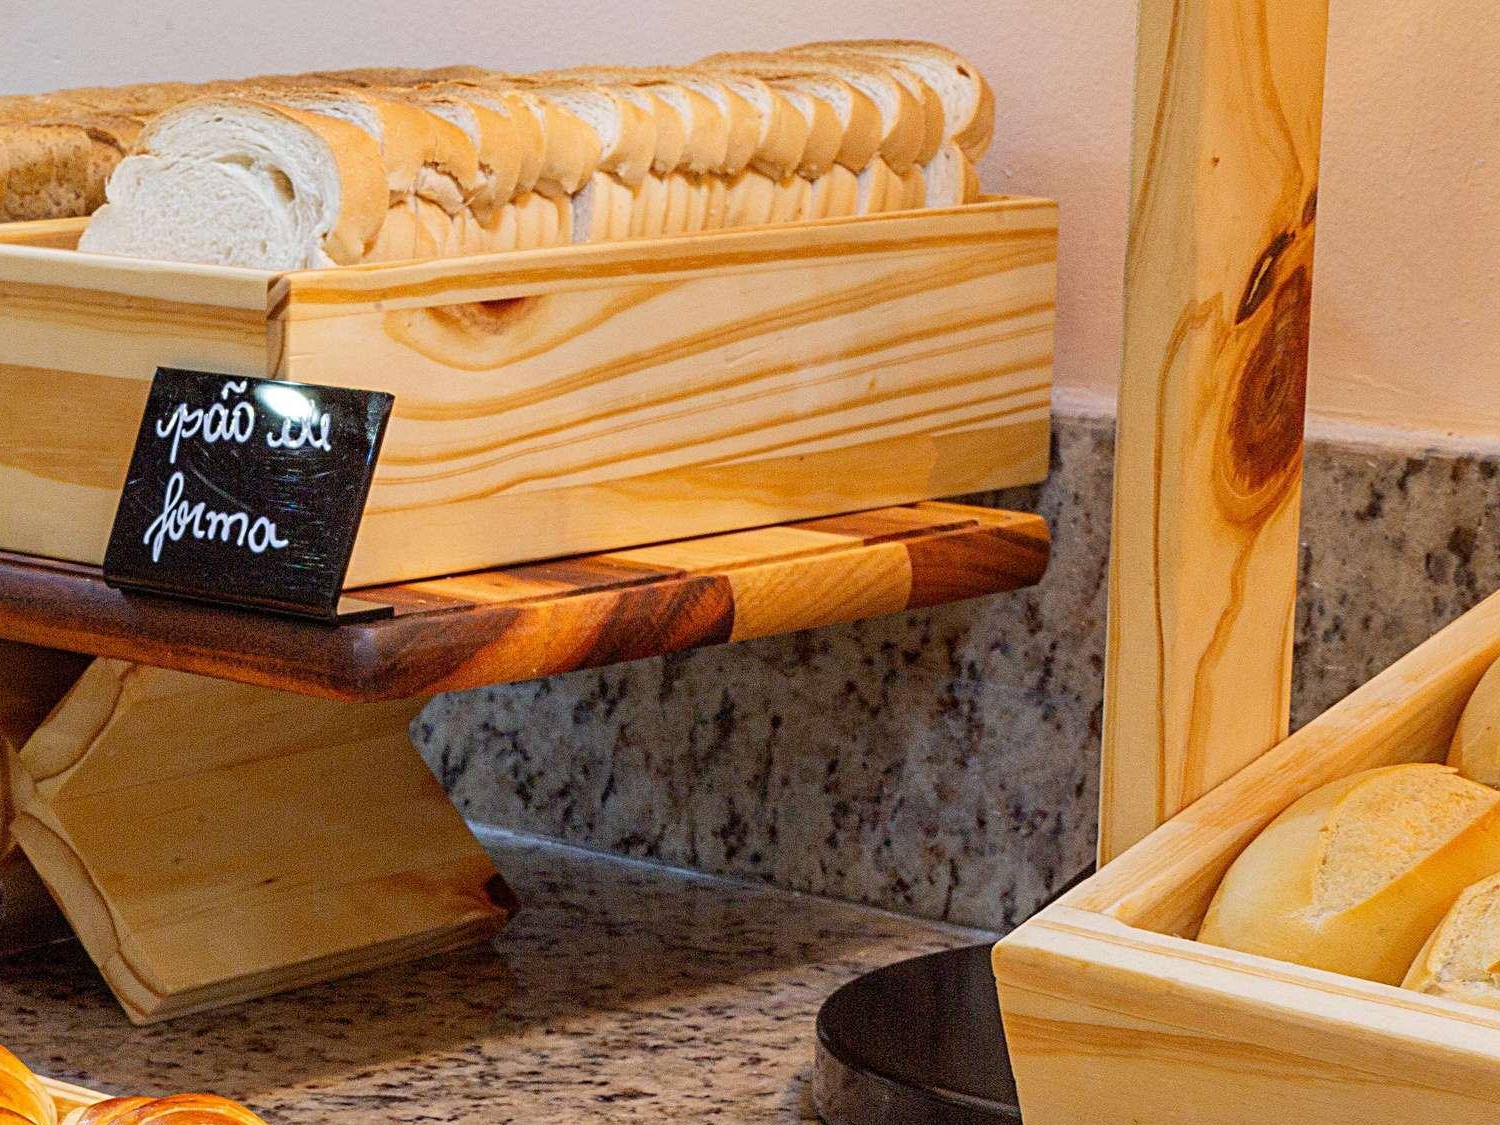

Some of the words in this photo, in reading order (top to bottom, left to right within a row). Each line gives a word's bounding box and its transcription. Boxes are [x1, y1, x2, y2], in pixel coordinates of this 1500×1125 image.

[156, 381, 254, 464] pão
[266, 400, 332, 452] de
[143, 472, 289, 563] forma
